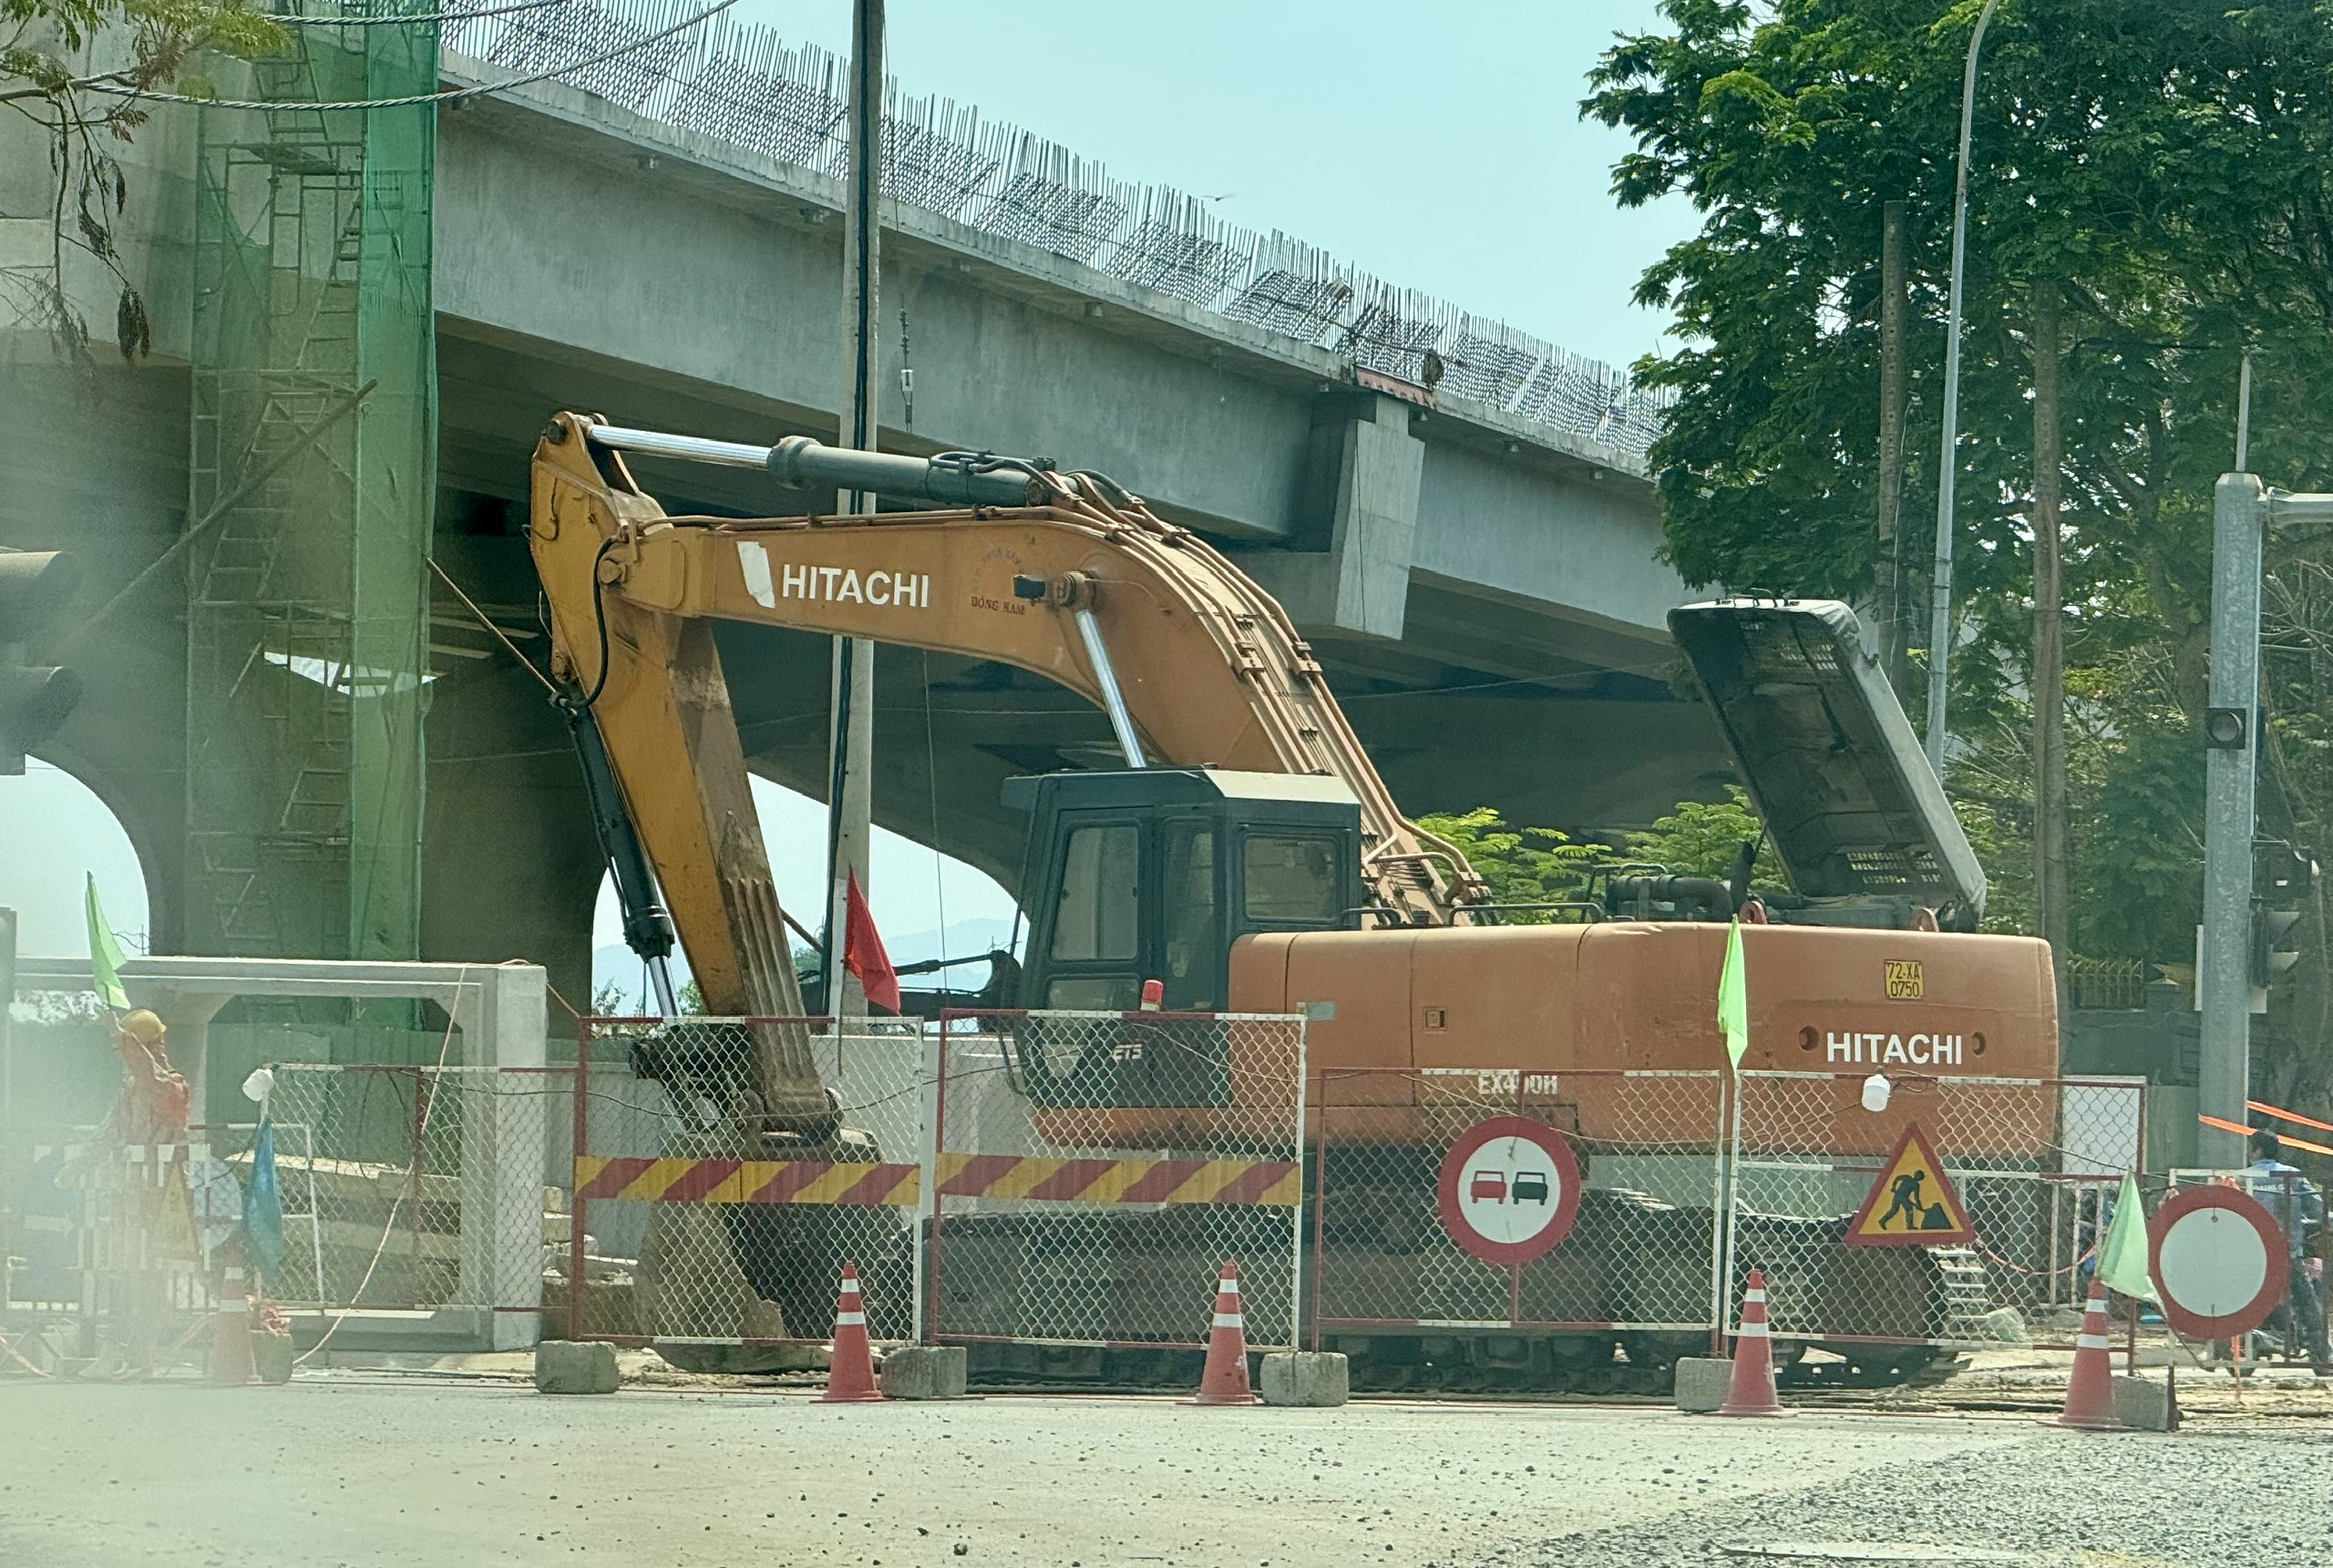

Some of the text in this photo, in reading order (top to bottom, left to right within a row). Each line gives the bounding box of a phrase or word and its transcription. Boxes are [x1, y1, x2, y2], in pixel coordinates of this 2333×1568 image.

[783, 564, 929, 608] HITACHI
[1003, 602, 1025, 616] NAM
[1890, 980, 1919, 997] 0750
[1826, 1032, 1962, 1064] HITACHI
